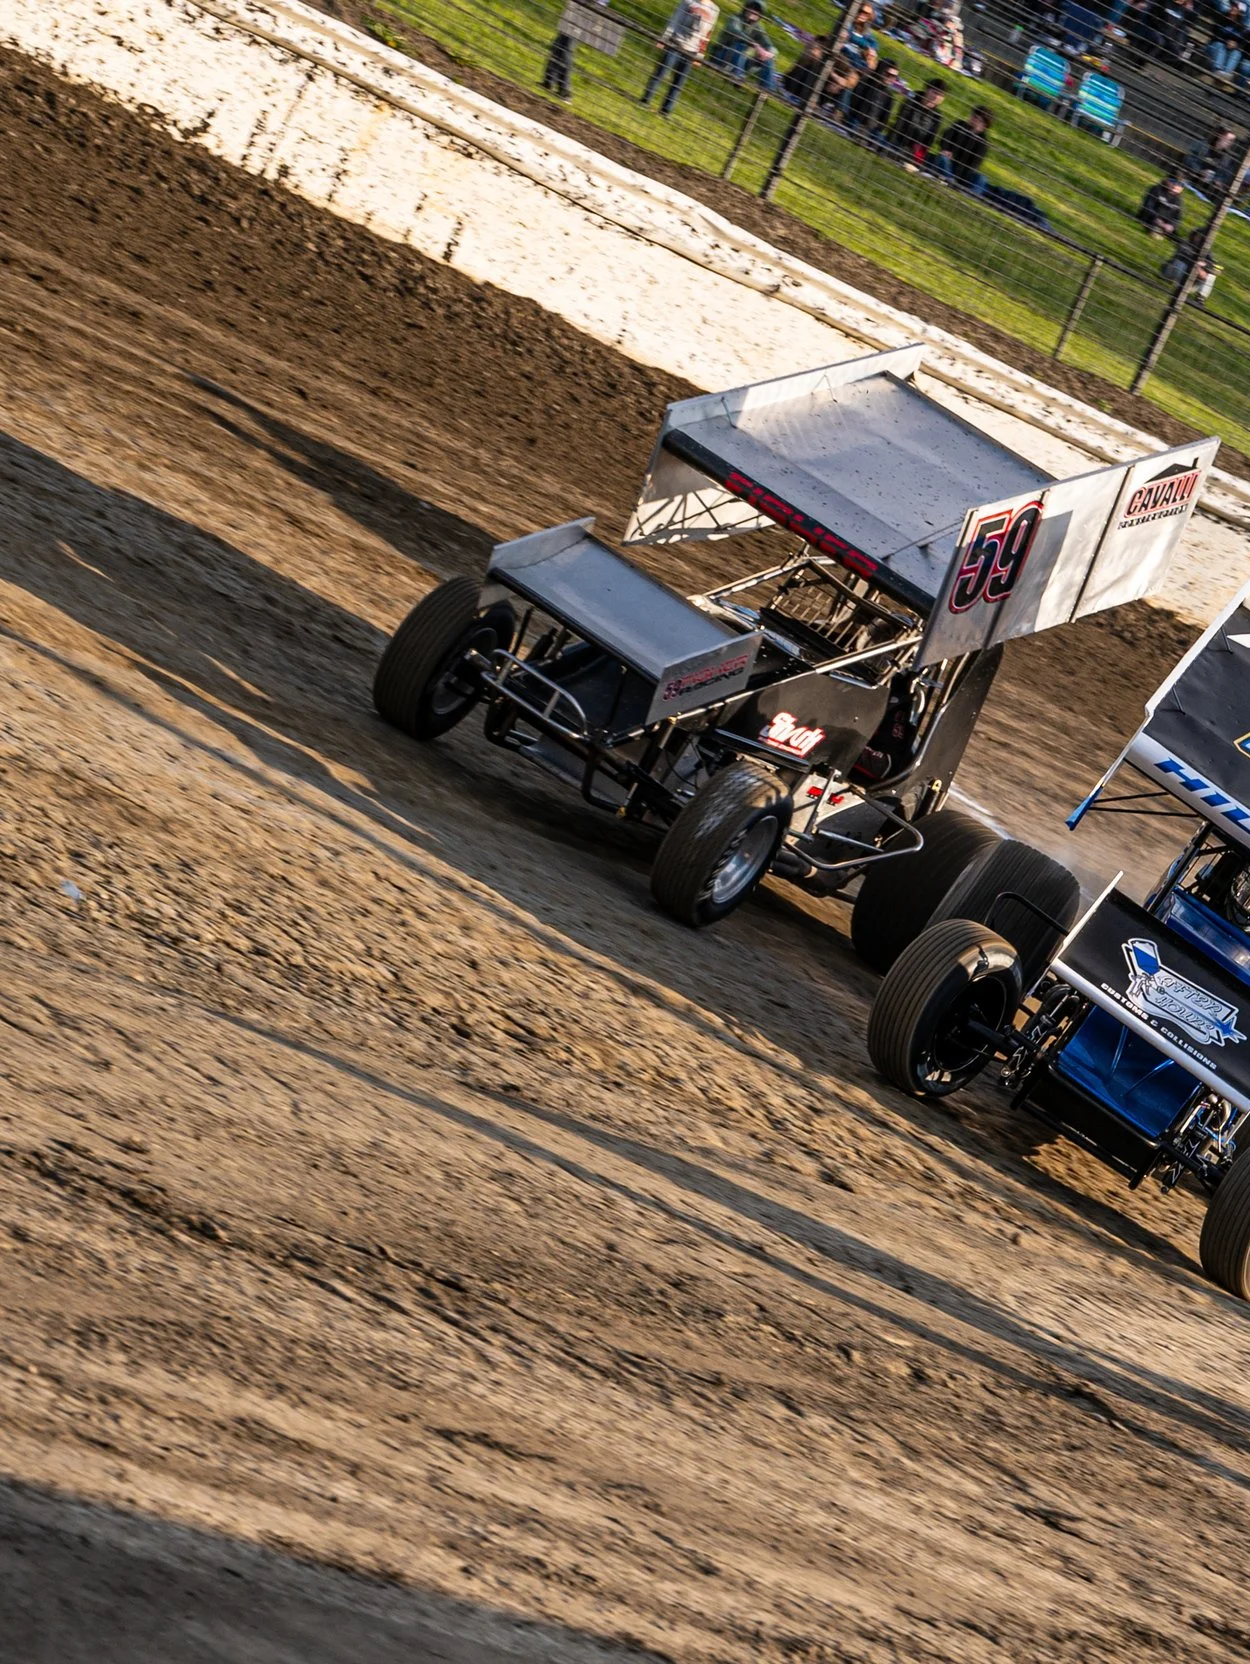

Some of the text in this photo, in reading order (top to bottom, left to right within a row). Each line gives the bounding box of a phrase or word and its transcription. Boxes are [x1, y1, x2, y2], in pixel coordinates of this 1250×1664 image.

[1125, 470, 1200, 517] CAVALLI
[948, 501, 1044, 614] 59
[1100, 982, 1149, 1021] CUSTOMS
[1159, 1026, 1218, 1071] COLLISIONS
[1157, 974, 1223, 1018] AFTER
